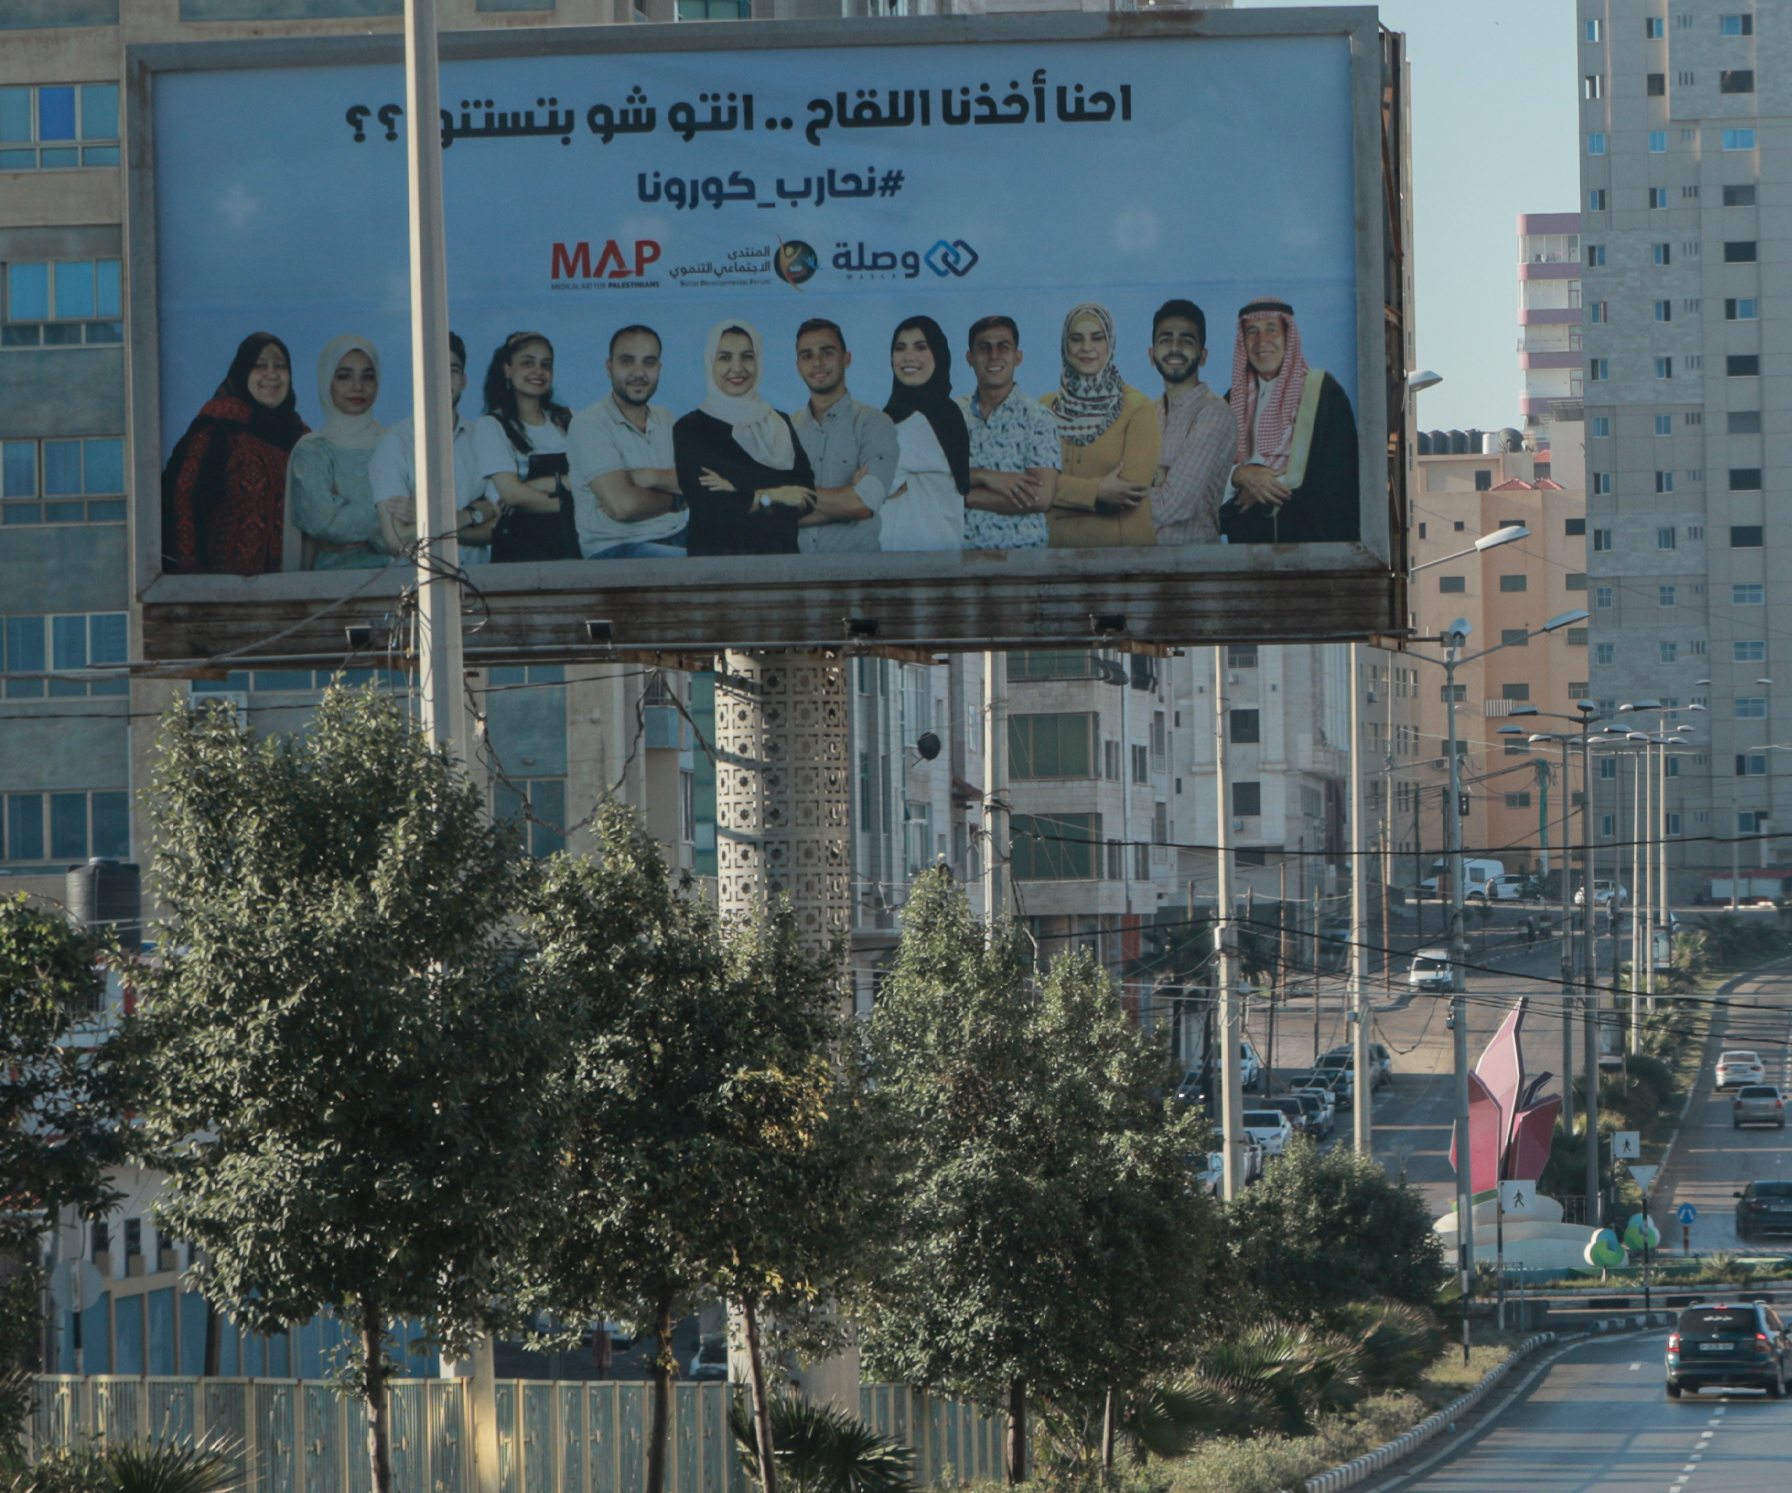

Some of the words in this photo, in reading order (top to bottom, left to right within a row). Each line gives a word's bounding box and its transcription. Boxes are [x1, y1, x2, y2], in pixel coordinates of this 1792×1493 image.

[586, 85, 656, 145] شو
[941, 68, 1047, 126] أخذنا
[1056, 83, 1132, 123] احنا
[667, 92, 754, 143] انتو
[805, 88, 931, 147] اللقاح
[551, 239, 662, 280] MAP
[669, 261, 713, 278] التنموي
[713, 261, 771, 278] الاجتماعي
[728, 246, 770, 260] المنتدى
[832, 242, 920, 279] وصلة
[551, 282, 580, 291] MEDICAL
[581, 282, 593, 290] AID
[593, 281, 607, 289] FOR
[608, 281, 660, 289] PALESTINIANS
